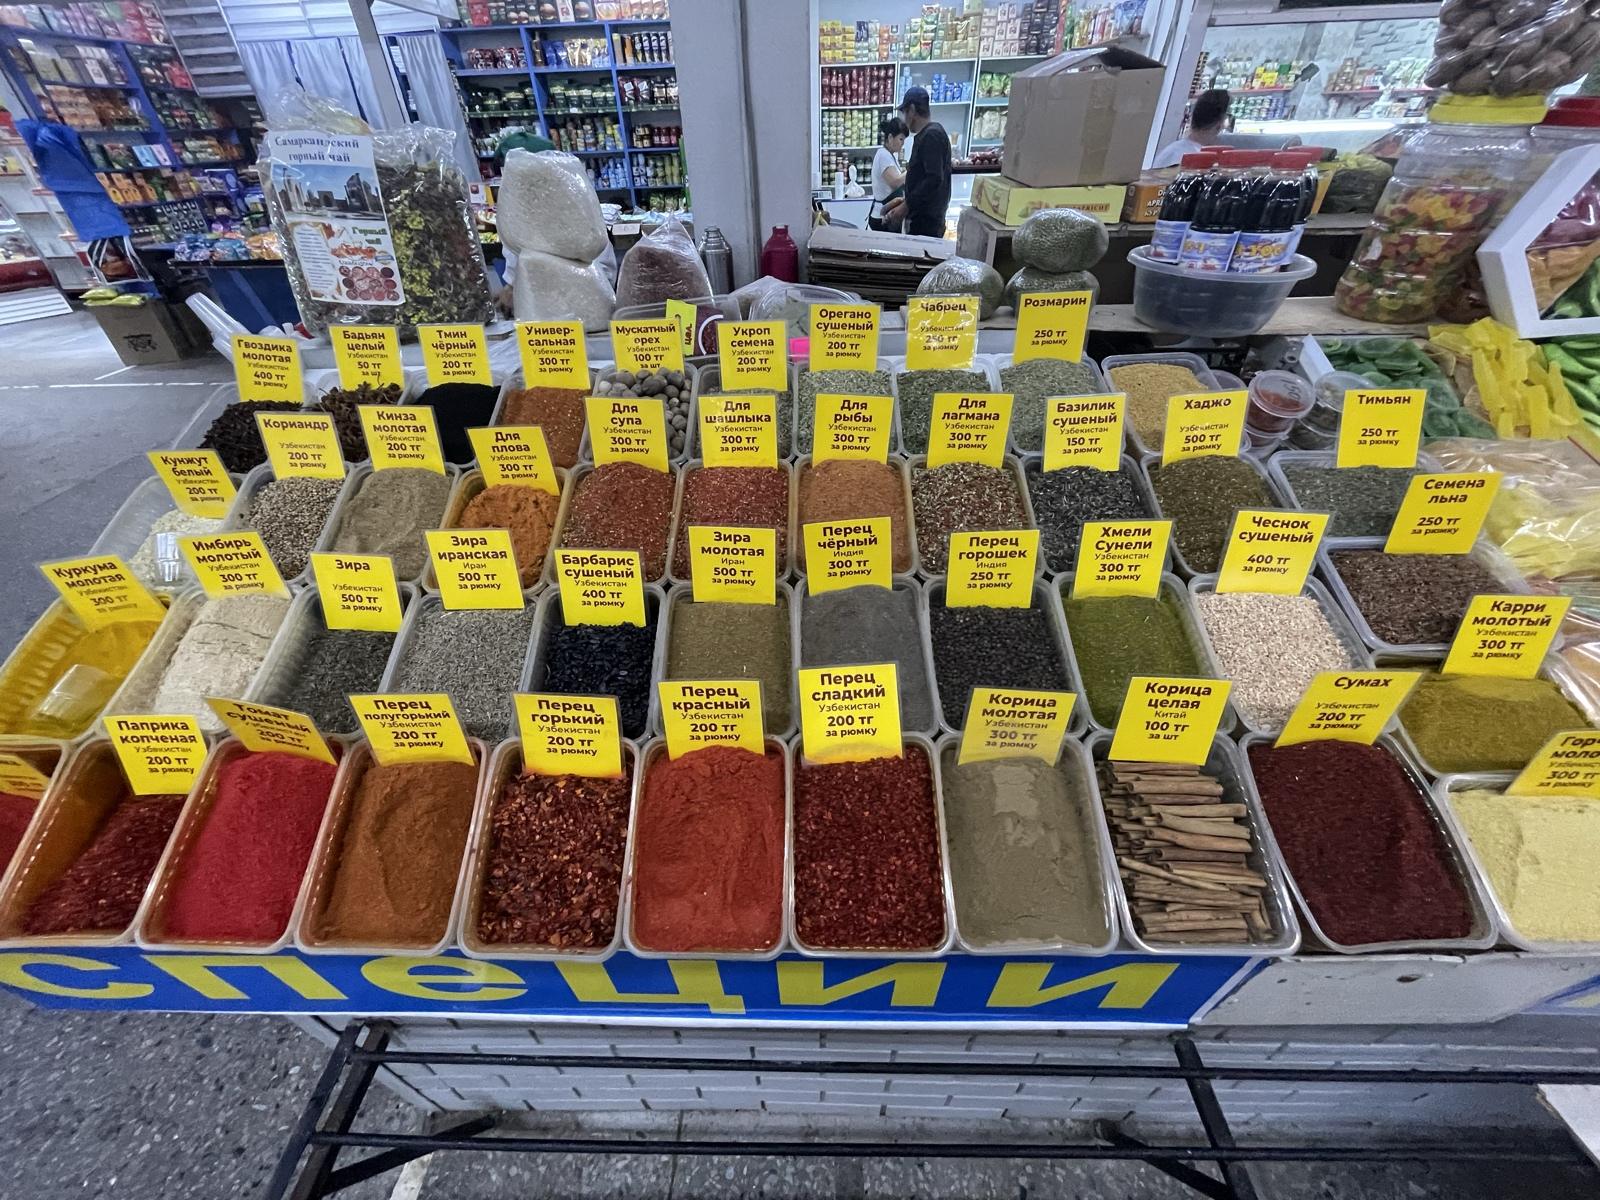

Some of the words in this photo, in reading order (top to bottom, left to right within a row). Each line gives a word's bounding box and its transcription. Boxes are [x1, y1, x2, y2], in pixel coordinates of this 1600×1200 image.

[288, 152, 325, 163] горный
[330, 152, 351, 163] чай
[920, 301, 967, 313] Чабрец
[1024, 297, 1087, 308] Розмарин
[819, 308, 872, 320] Орегано
[524, 325, 575, 337] Универ-
[615, 323, 676, 336] Мускатный
[732, 326, 771, 338] Укроп
[816, 320, 873, 332] сушеный
[342, 330, 386, 341] Бадьян
[436, 329, 468, 340] Тмин
[822, 331, 866, 339] Узбекистан
[1034, 329, 1053, 339] 250
[1055, 330, 1068, 338] тг
[237, 339, 293, 353] Гвоздика
[346, 340, 385, 352] целый
[431, 339, 477, 352] чёрный
[527, 338, 576, 347] сальная
[634, 336, 660, 346] орех
[730, 338, 774, 348] семена
[828, 341, 846, 350] 200
[849, 341, 860, 350] тг
[242, 352, 292, 363] молотая
[835, 351, 862, 359] рюмку
[538, 357, 558, 366] 300
[559, 358, 571, 366] тг
[253, 371, 272, 380] 400
[274, 372, 286, 380] тг
[840, 399, 868, 412] Для
[958, 397, 987, 410] Для
[1183, 397, 1232, 411] Хаджо
[1357, 394, 1412, 405] Тимьян
[611, 402, 639, 415] Для
[723, 400, 751, 413] Для
[1056, 401, 1116, 413] Базилик
[376, 410, 417, 422] Кинза
[610, 416, 643, 428] супа
[704, 414, 772, 424] шашлыка
[833, 412, 873, 425] рыбы
[941, 412, 1000, 422] лагмана
[1052, 412, 1118, 427] сушеный
[262, 418, 330, 432] Кориандр
[372, 424, 427, 433] молотая
[945, 422, 995, 430] Узбекистан
[494, 431, 521, 443] Для
[949, 432, 972, 442] 300
[974, 434, 988, 442] тг
[1184, 433, 1206, 444] 500
[1208, 434, 1222, 442] тг
[1360, 428, 1383, 438] 250
[1385, 429, 1400, 437] тг
[386, 442, 408, 452] 200
[408, 444, 422, 452] тг
[610, 436, 633, 446] 300
[634, 438, 647, 446] тг
[491, 444, 531, 453] плова
[160, 456, 209, 468] Кунжут
[171, 465, 213, 477] белый
[1424, 478, 1486, 490] Семена
[1427, 494, 1468, 504] льна
[1252, 516, 1311, 530] Чеснок
[1416, 516, 1444, 527] 250
[1446, 518, 1462, 526] тг
[713, 530, 751, 545] Зира
[822, 525, 873, 539] Перец
[1100, 526, 1152, 538] Хмели
[1238, 531, 1314, 544] сушеный
[1423, 527, 1460, 536] рюмку
[192, 538, 252, 552] Имбирь
[450, 535, 488, 549] Зира
[817, 536, 878, 551] чёрный
[969, 536, 1019, 549] Перец
[1095, 540, 1153, 554] Сунели
[195, 548, 262, 564] молотый
[437, 550, 508, 563] иранская
[700, 546, 765, 557] молотая
[833, 549, 864, 558] Индия
[958, 549, 1028, 562] горошек
[561, 554, 635, 568] Барбарис
[721, 557, 745, 566] Иран
[828, 559, 853, 570] 300
[855, 559, 870, 568] тг
[976, 561, 1008, 569] Индия
[1246, 554, 1274, 565] 400
[1276, 557, 1291, 565] тг
[52, 562, 118, 579] Куркума
[334, 559, 371, 573] Зира
[462, 562, 487, 571] Иран
[713, 566, 738, 577] 500
[739, 569, 754, 578] тг
[1098, 563, 1124, 573] 300
[1127, 564, 1142, 572] тг
[1254, 566, 1289, 575] рюмку
[458, 572, 481, 582] 500
[483, 573, 498, 581] тг
[564, 567, 635, 580] сушеный
[839, 568, 872, 578] рюмку
[64, 573, 126, 589] молотая
[574, 579, 628, 588] Узбекистан
[724, 578, 756, 587] рюмку
[582, 589, 607, 599] 400
[608, 591, 623, 599] тг
[593, 600, 625, 608] рюмку
[1490, 600, 1547, 616] Карри
[1472, 616, 1552, 627] молотый
[820, 672, 876, 688] Перец
[1333, 675, 1392, 690] Сумах
[681, 686, 740, 700] Перец
[811, 687, 886, 702] сладкий
[1144, 681, 1213, 698] Корица
[373, 699, 433, 713] Перец
[537, 699, 596, 714] Перец
[672, 697, 751, 713] красный
[988, 693, 1057, 709] Корица
[1147, 698, 1201, 710] целая
[818, 702, 881, 713] Узбекистан
[364, 710, 451, 723] полугорький
[531, 713, 605, 725] горький
[981, 708, 1058, 720] молотая
[1154, 710, 1187, 719] Китай
[116, 720, 190, 733] Паприка
[827, 714, 855, 727] 200
[858, 715, 874, 725] тг
[1145, 720, 1170, 732] 100
[1173, 724, 1190, 732] тг
[537, 725, 601, 735] Узбекистан
[690, 722, 718, 733] 200
[720, 724, 738, 732] тг
[840, 727, 878, 738] рюмку
[119, 734, 198, 744] копченая
[391, 730, 417, 740] 200
[421, 731, 438, 740] тг
[546, 735, 575, 746] 200
[578, 738, 594, 747] тг
